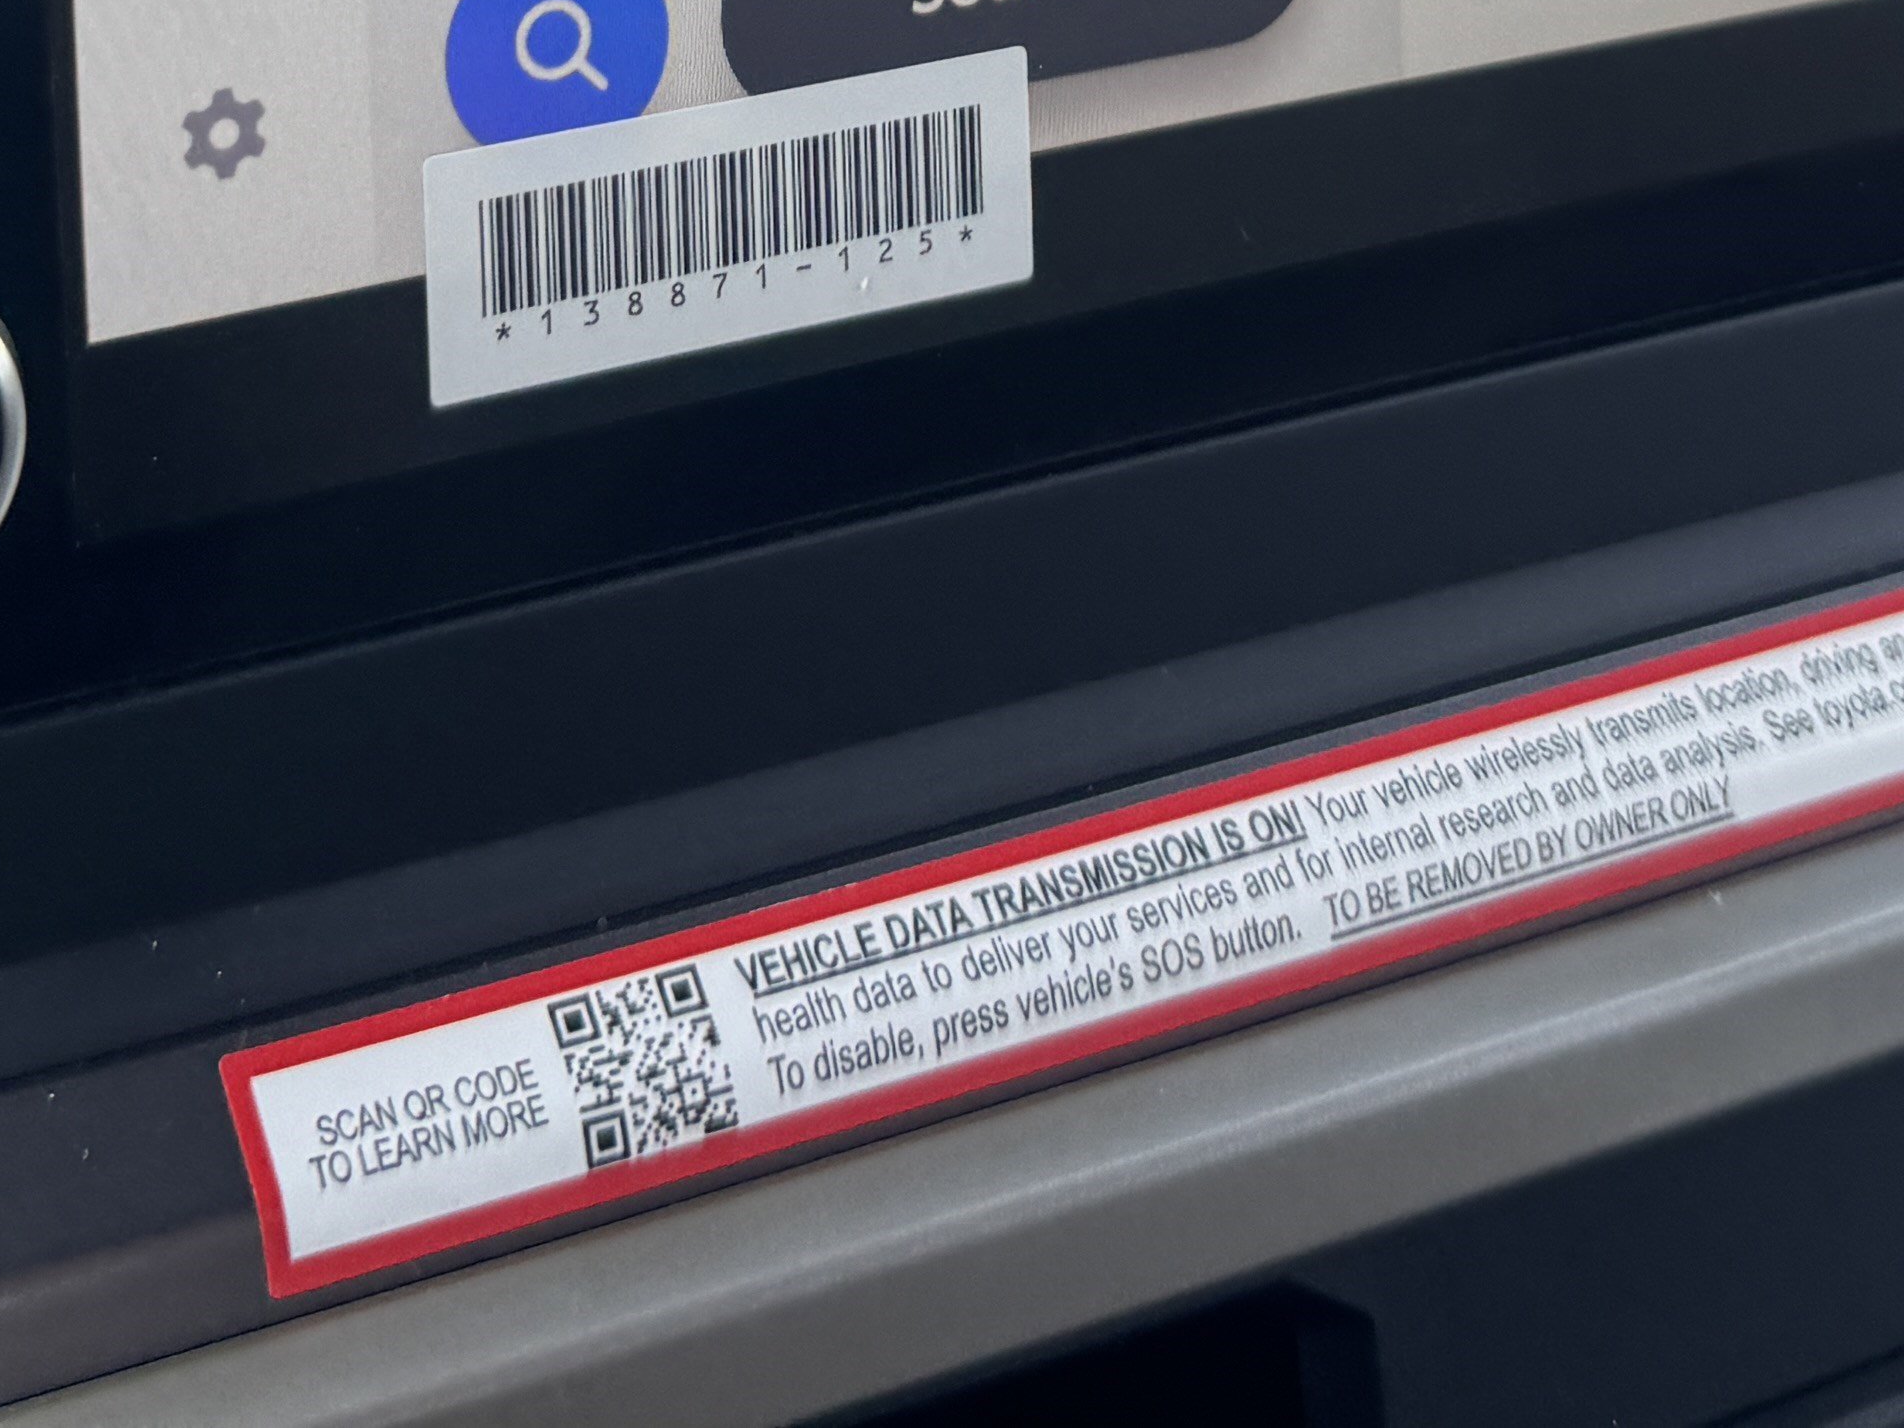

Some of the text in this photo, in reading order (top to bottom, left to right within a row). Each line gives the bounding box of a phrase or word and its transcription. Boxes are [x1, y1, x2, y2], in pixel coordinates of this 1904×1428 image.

[734, 921, 883, 992] VEHICLE
[883, 900, 975, 950] DATA
[972, 828, 1210, 923] TRANSMISSION
[1211, 818, 1247, 856] IS
[1249, 798, 1306, 845] ON!
[1305, 789, 1370, 829] Your
[1378, 760, 1464, 807] vehicle
[1465, 723, 1586, 784] wirelessly
[1590, 694, 1698, 746] transmits
[1801, 643, 1880, 687] driving
[753, 981, 848, 1044] health
[853, 964, 918, 1015] data
[922, 959, 954, 996] to
[961, 932, 1065, 983] deliver
[1057, 910, 1120, 965] your
[1128, 882, 1238, 933] services
[1243, 850, 1295, 898] and
[1297, 846, 1334, 887] for
[1339, 819, 1434, 871] internal
[1437, 786, 1549, 842] research
[1555, 764, 1600, 808] and
[1603, 746, 1659, 793] data
[1762, 707, 1815, 742] See
[767, 774, 1732, 1097] To disable, press vehicle's SOS button. TO BE REMOVED BY OWNER ONLY
[309, 1094, 550, 1190] TO LEARN MORE
[316, 1058, 540, 1146] SCAN QR CODE
